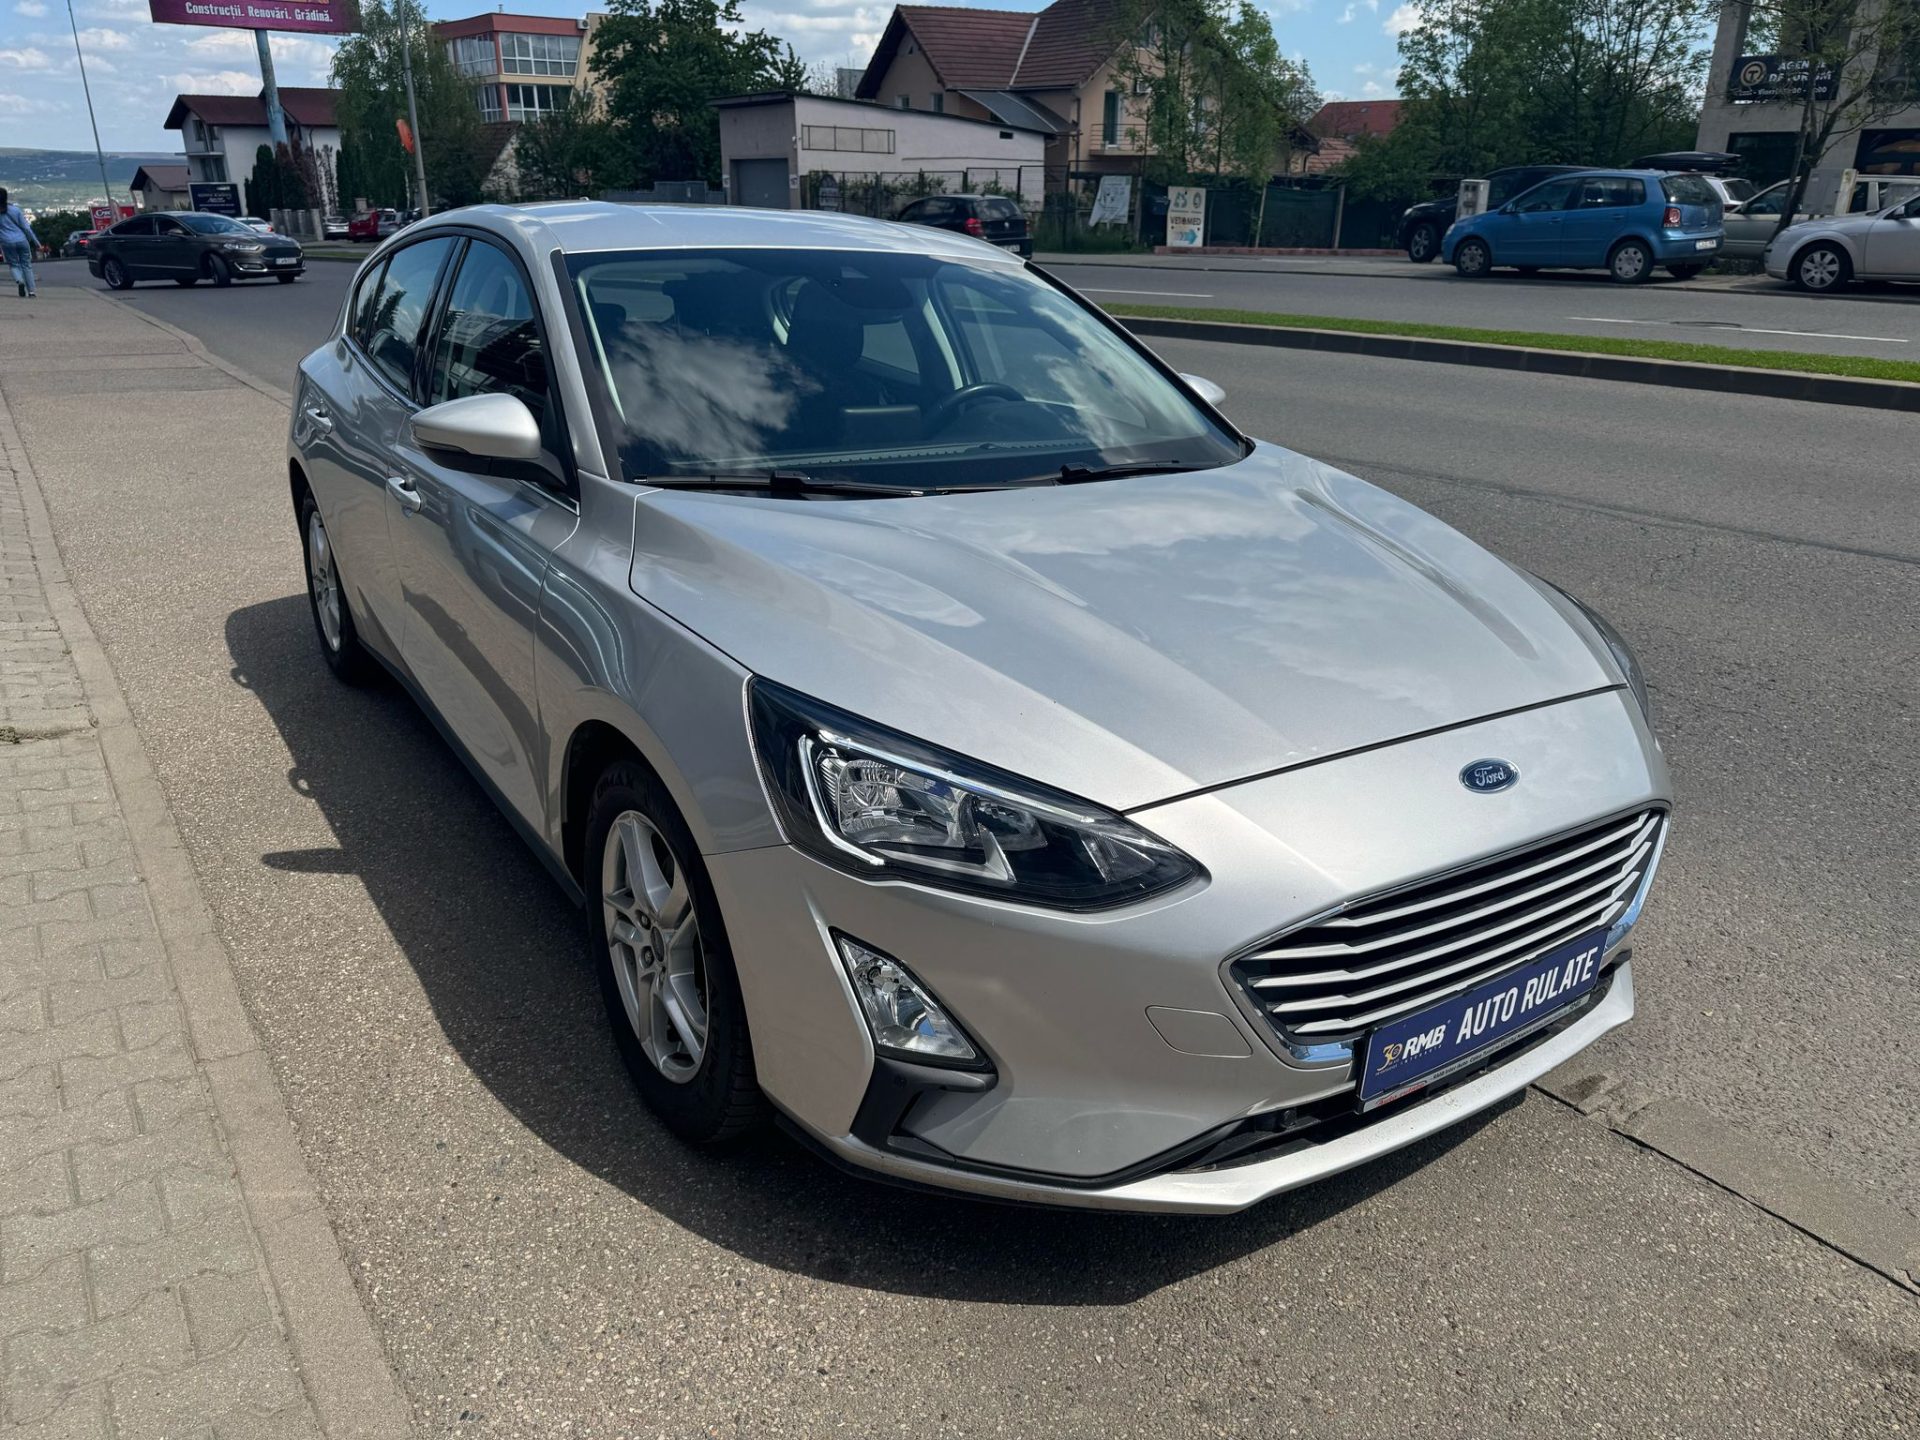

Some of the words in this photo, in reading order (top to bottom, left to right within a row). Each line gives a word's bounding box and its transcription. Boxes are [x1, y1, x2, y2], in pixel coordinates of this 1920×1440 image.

[186, 2, 245, 19] Construcții.
[248, 6, 292, 20] Renovări.
[295, 10, 333, 22] Grădină.
[1474, 766, 1506, 787] Ford
[1402, 1024, 1446, 1060] RMB
[1456, 987, 1519, 1045] AUTO
[1521, 947, 1598, 1013] RULATE
